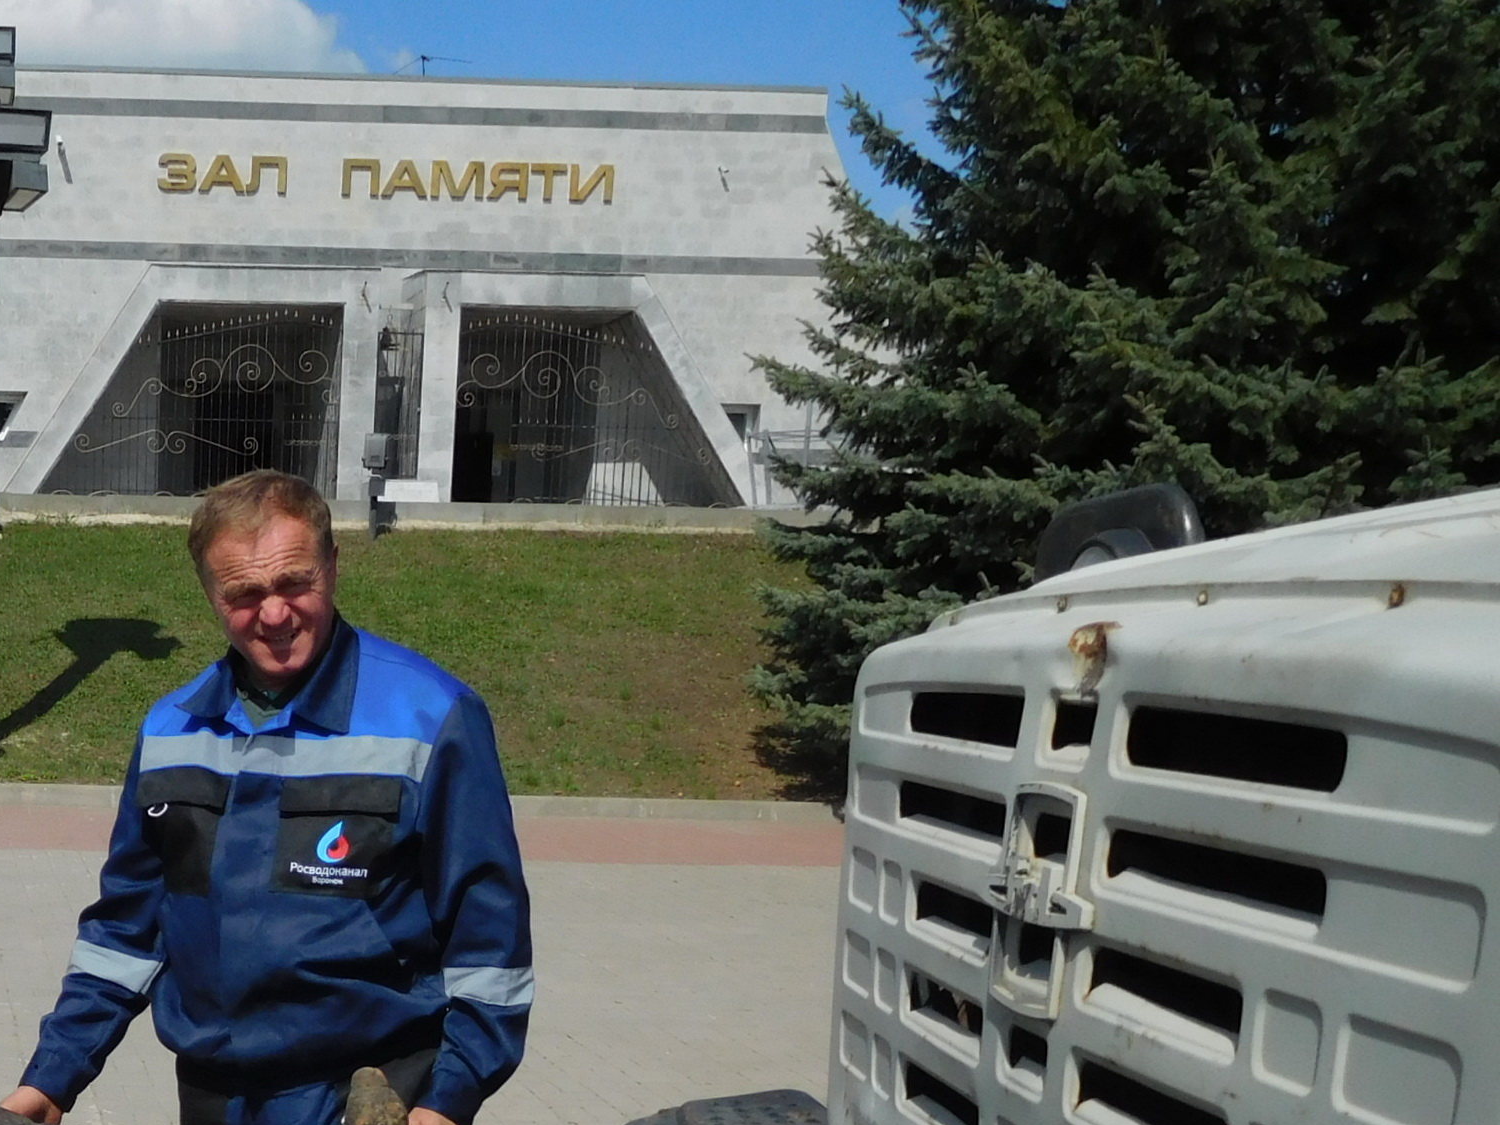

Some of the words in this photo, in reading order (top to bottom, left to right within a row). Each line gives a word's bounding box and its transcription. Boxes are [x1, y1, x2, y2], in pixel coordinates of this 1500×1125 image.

[158, 153, 288, 197] ЗАЛ
[341, 157, 616, 204] ПАМЯТИ
[289, 861, 368, 878] Росводоканал
